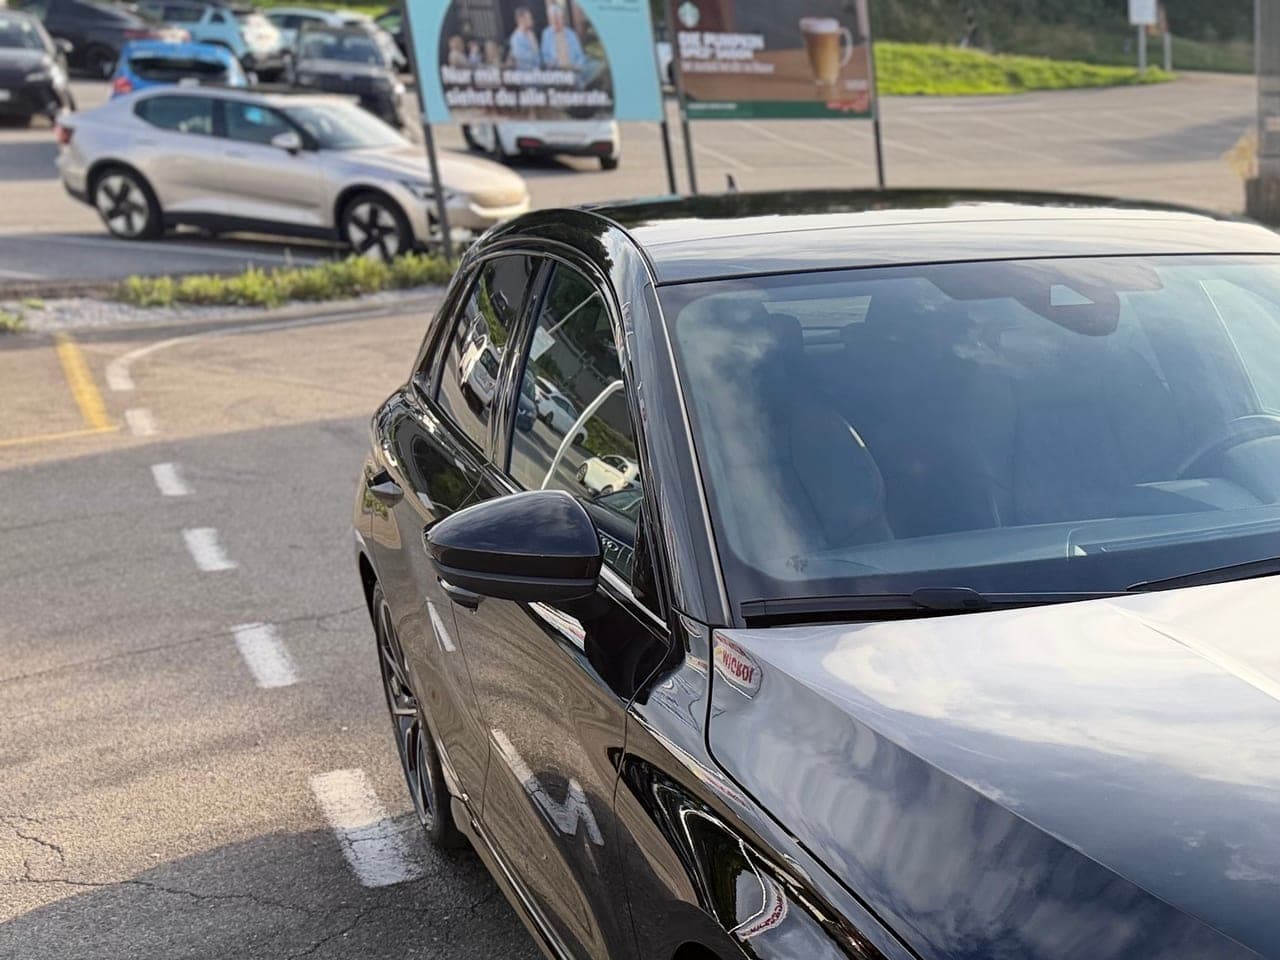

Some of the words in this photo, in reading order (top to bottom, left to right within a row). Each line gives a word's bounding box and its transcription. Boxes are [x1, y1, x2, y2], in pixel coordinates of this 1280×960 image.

[441, 65, 472, 85] Nur
[474, 66, 501, 86] mit
[503, 68, 576, 86] newhome
[446, 86, 493, 107] siehst
[495, 87, 517, 107] du
[519, 87, 547, 107] alle
